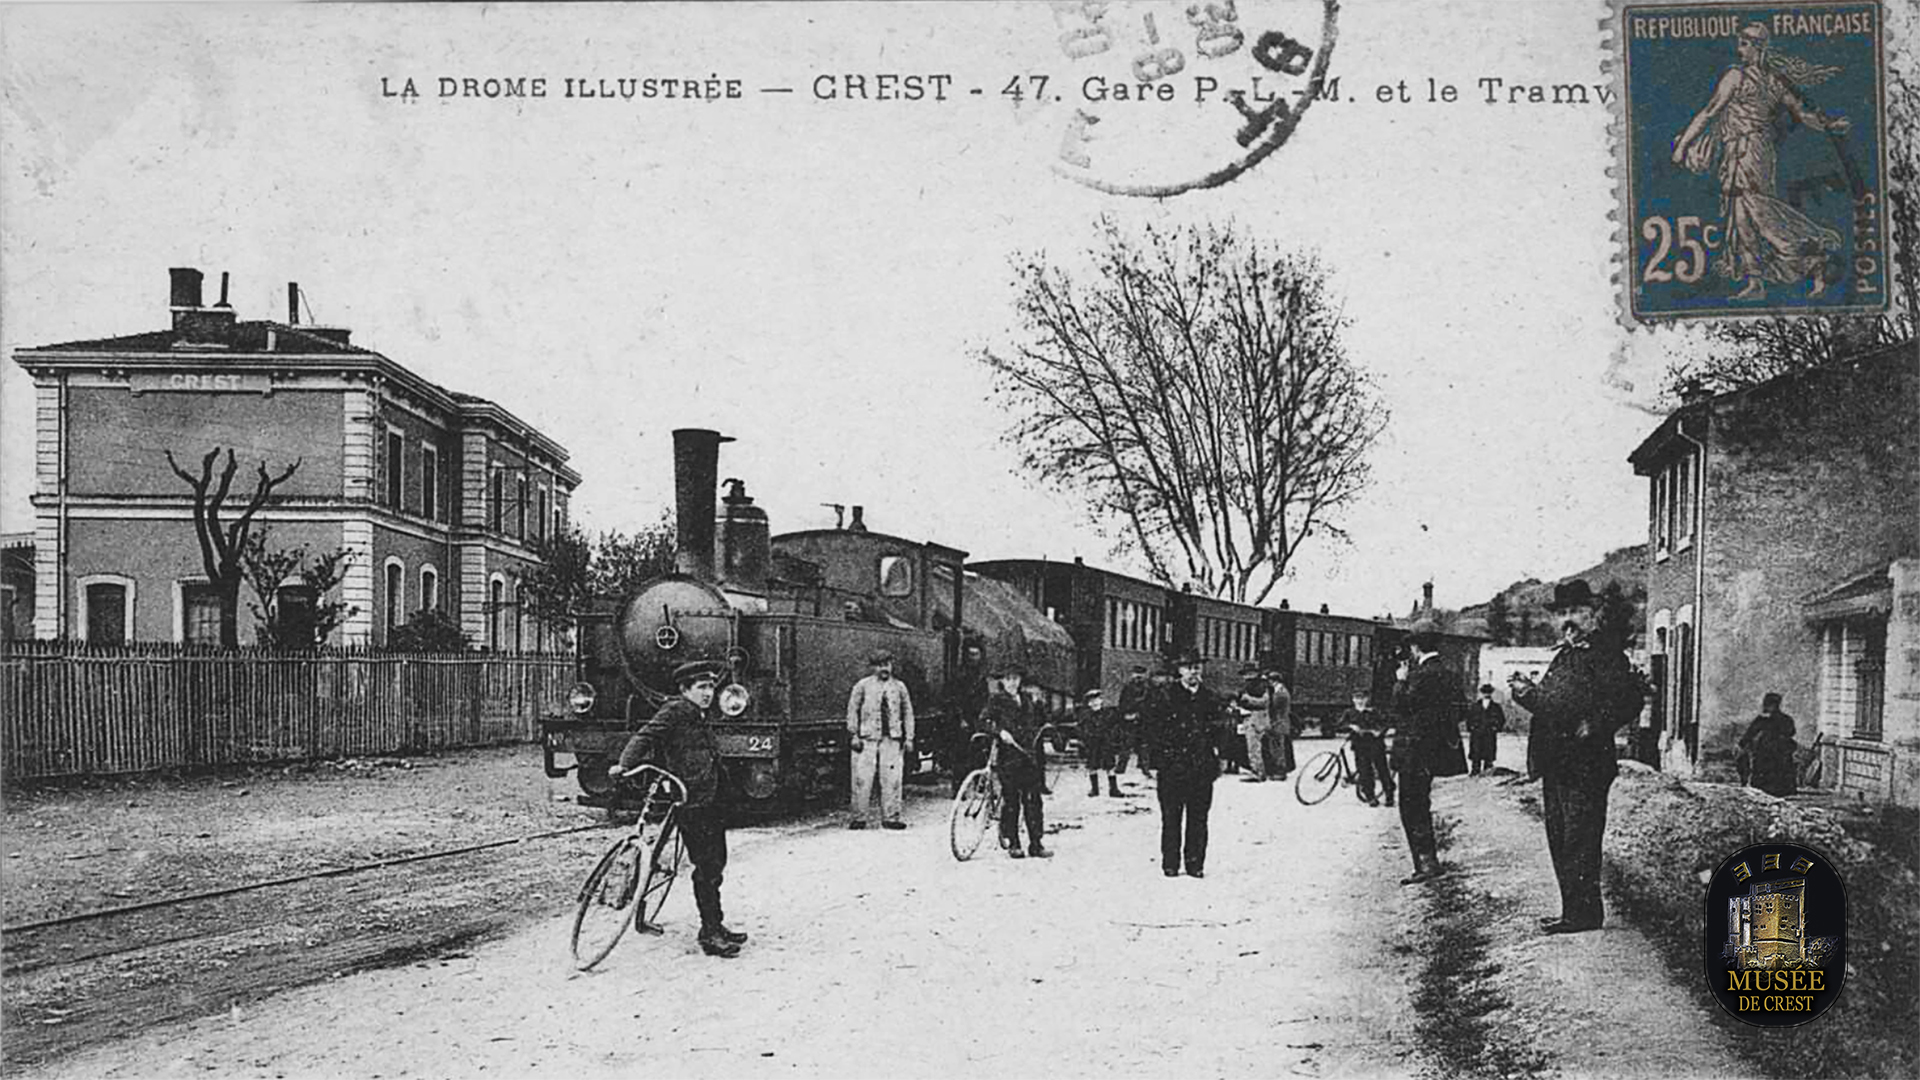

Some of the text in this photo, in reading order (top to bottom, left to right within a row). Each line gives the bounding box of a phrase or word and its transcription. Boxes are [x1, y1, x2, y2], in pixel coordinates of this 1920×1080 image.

[1773, 12, 1872, 37] FRANÇAISE
[171, 374, 241, 390] CREST
[749, 736, 772, 751] 24
